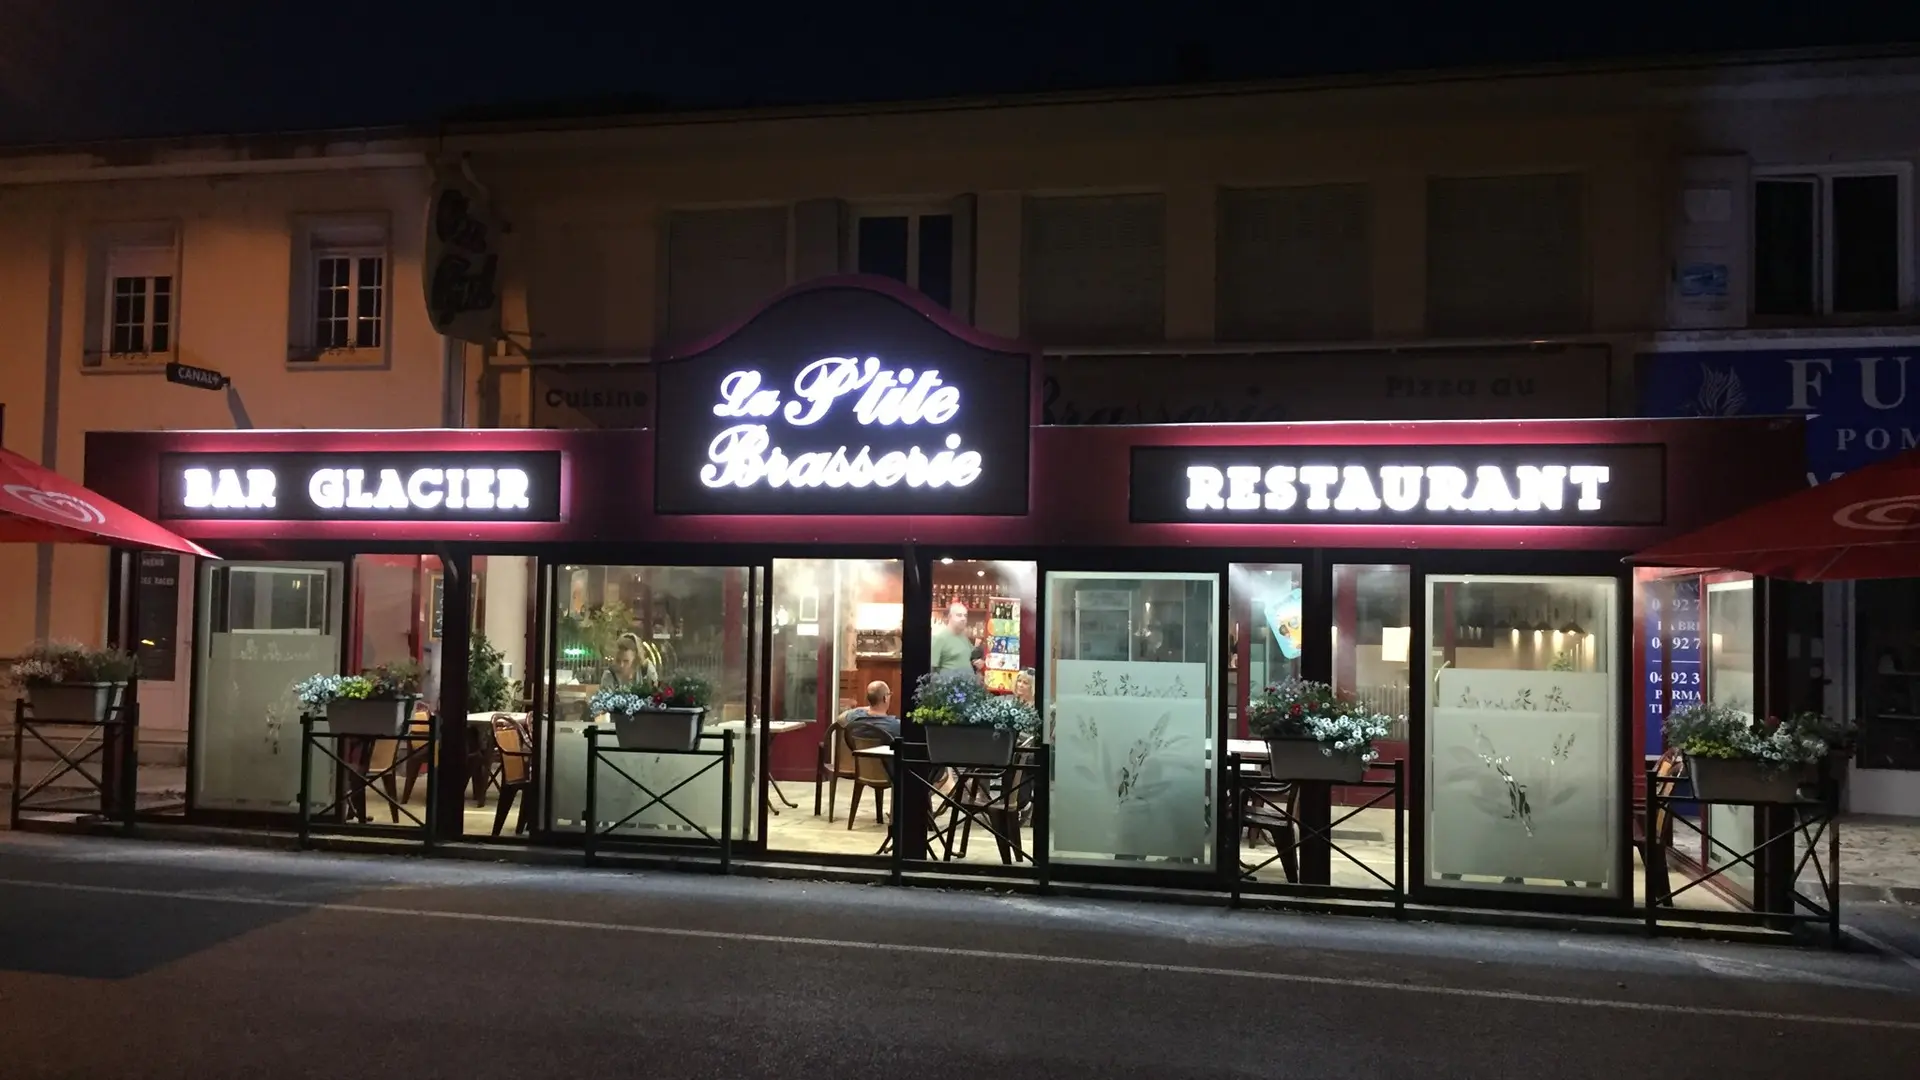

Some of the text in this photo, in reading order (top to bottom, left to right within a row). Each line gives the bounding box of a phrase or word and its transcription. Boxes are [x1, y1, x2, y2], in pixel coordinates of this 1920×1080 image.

[712, 356, 961, 426] La P'tite
[700, 423, 983, 489] Brasserie
[183, 467, 530, 510] BAR GLACIER
[1185, 464, 1611, 512] RESTAURANT
[1672, 637, 1689, 650] 92
[1655, 689, 1701, 700] PRMA
[1671, 671, 1688, 684] 92
[1691, 672, 1700, 685] 3
